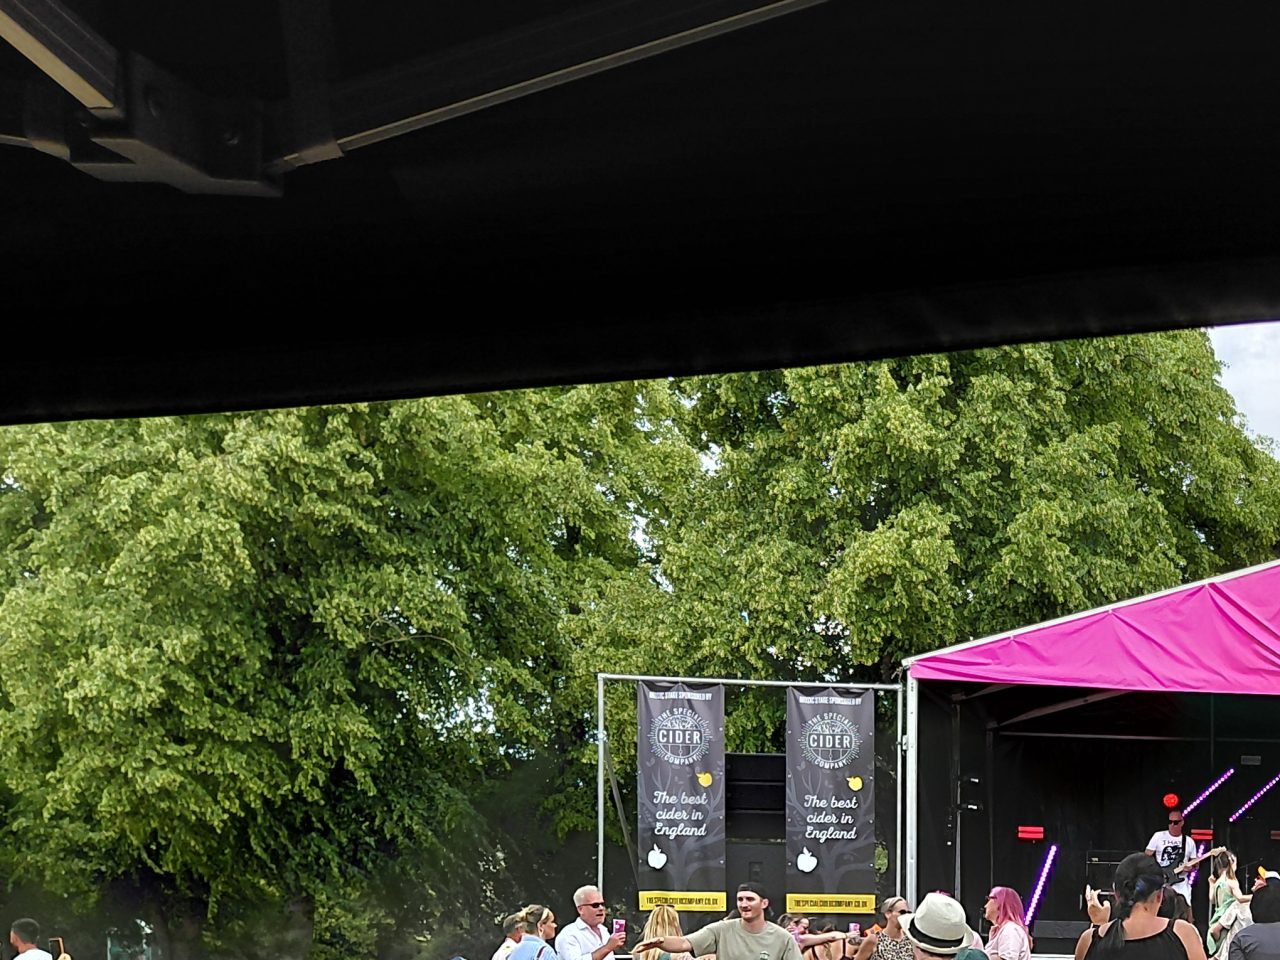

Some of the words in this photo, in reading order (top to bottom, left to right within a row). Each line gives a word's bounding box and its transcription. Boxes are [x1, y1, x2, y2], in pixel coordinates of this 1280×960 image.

[658, 709, 672, 721] THE
[673, 707, 703, 723] SPECIAL
[808, 714, 822, 727] THE
[823, 712, 853, 728] SPECIAL
[659, 730, 701, 743] CIDER
[810, 734, 851, 748] CIDER
[664, 753, 699, 765] COMPANY
[814, 758, 848, 769] COMPANY
[653, 791, 678, 804] The
[681, 791, 708, 804] best
[804, 794, 828, 808] The
[830, 796, 858, 809] best
[656, 807, 690, 820] cider
[691, 809, 704, 820] in
[806, 811, 839, 823] cider
[841, 813, 854, 824] in
[654, 821, 707, 840] England
[805, 825, 857, 843] England
